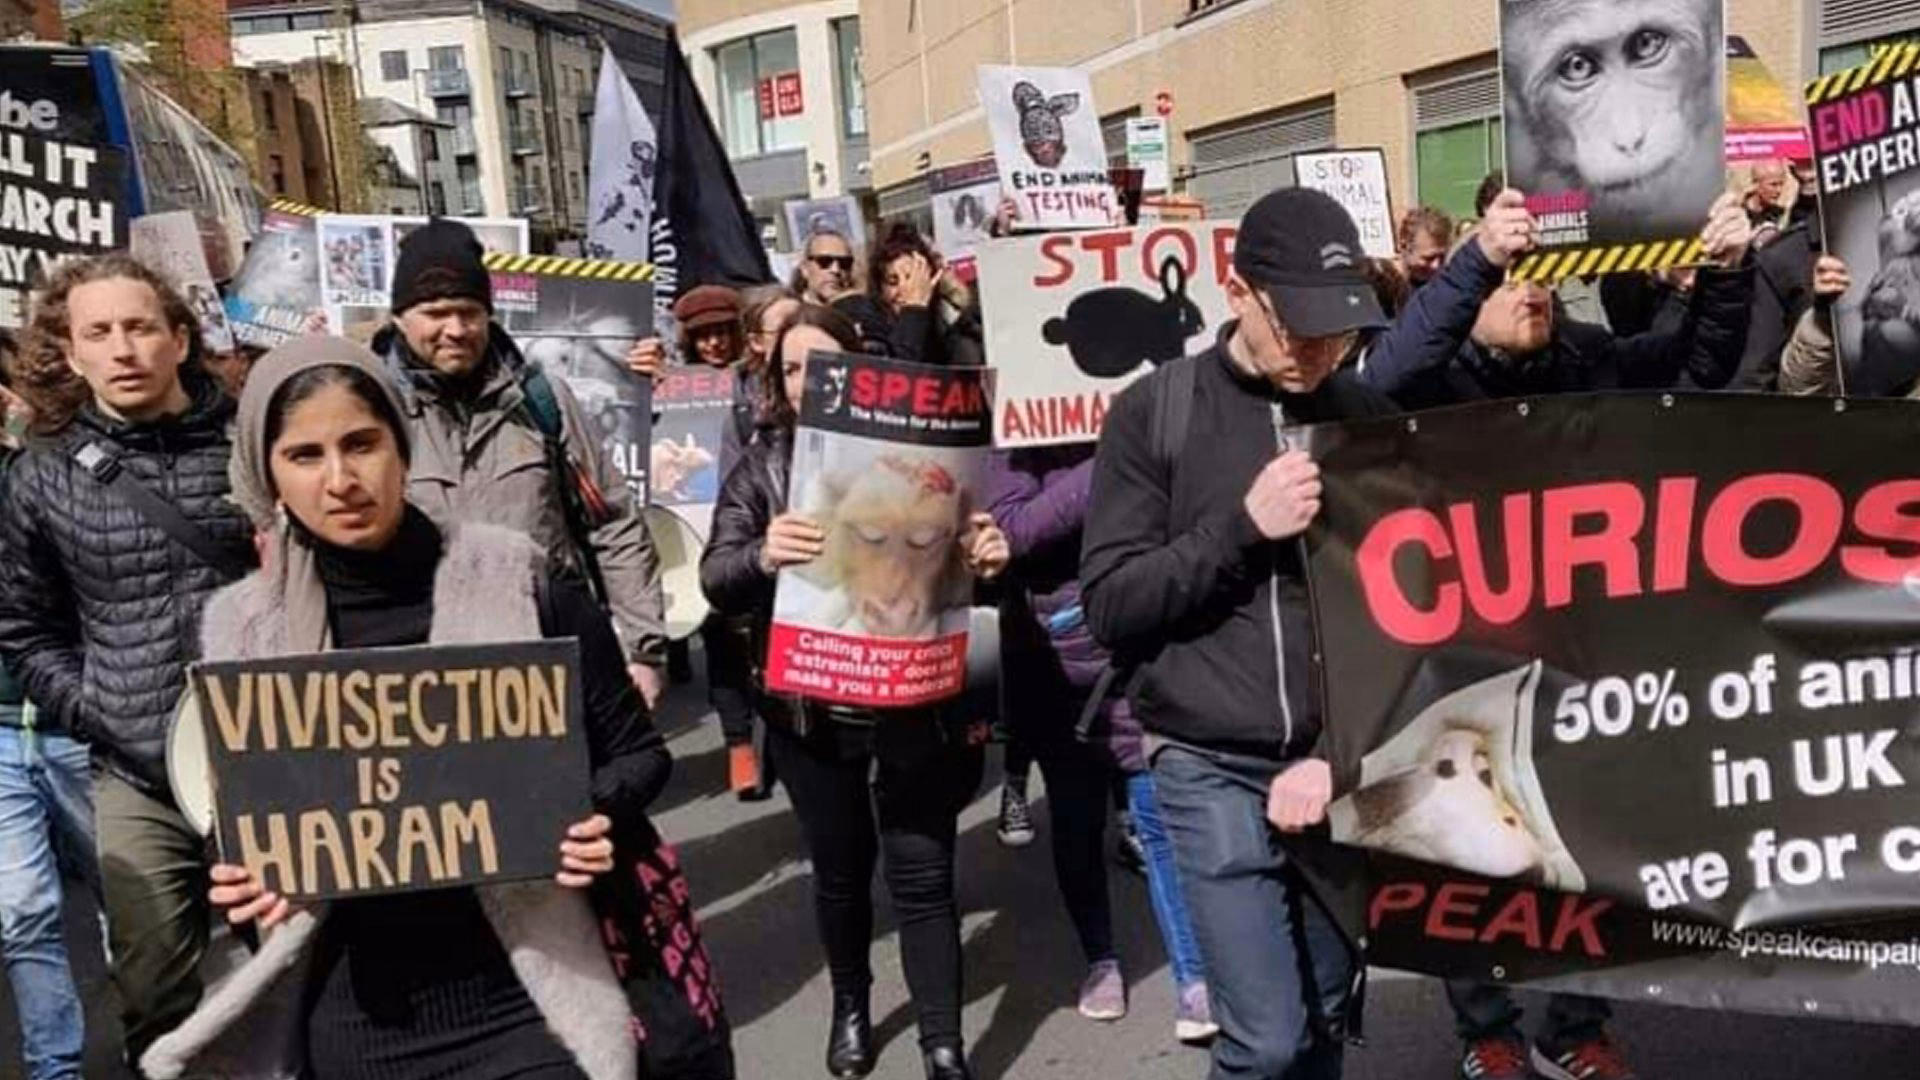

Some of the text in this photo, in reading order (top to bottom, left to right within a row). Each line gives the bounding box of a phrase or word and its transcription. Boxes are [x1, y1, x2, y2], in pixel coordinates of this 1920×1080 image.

[1815, 90, 1886, 151] END
[45, 141, 97, 188] IT
[1012, 170, 1055, 189] END
[0, 184, 114, 247] ARCH
[1026, 191, 1112, 221] TESTING
[652, 369, 733, 401] PEA
[1003, 391, 1112, 439] ANIMA
[1357, 472, 1920, 646] CURIOS
[799, 632, 864, 664] Calling
[868, 648, 911, 662] your
[205, 664, 567, 752] VIVISECTION
[782, 668, 833, 690] make
[837, 679, 874, 697] you
[877, 682, 891, 696] a
[1553, 648, 1920, 743] 50% of ani
[357, 757, 401, 805] IS
[1711, 728, 1906, 809] in UK
[237, 799, 499, 895] HARAM
[1638, 851, 1730, 911] are
[1746, 828, 1858, 890] for
[1369, 882, 1613, 958] PEAK
[1651, 919, 1920, 970] www.speakcampai
